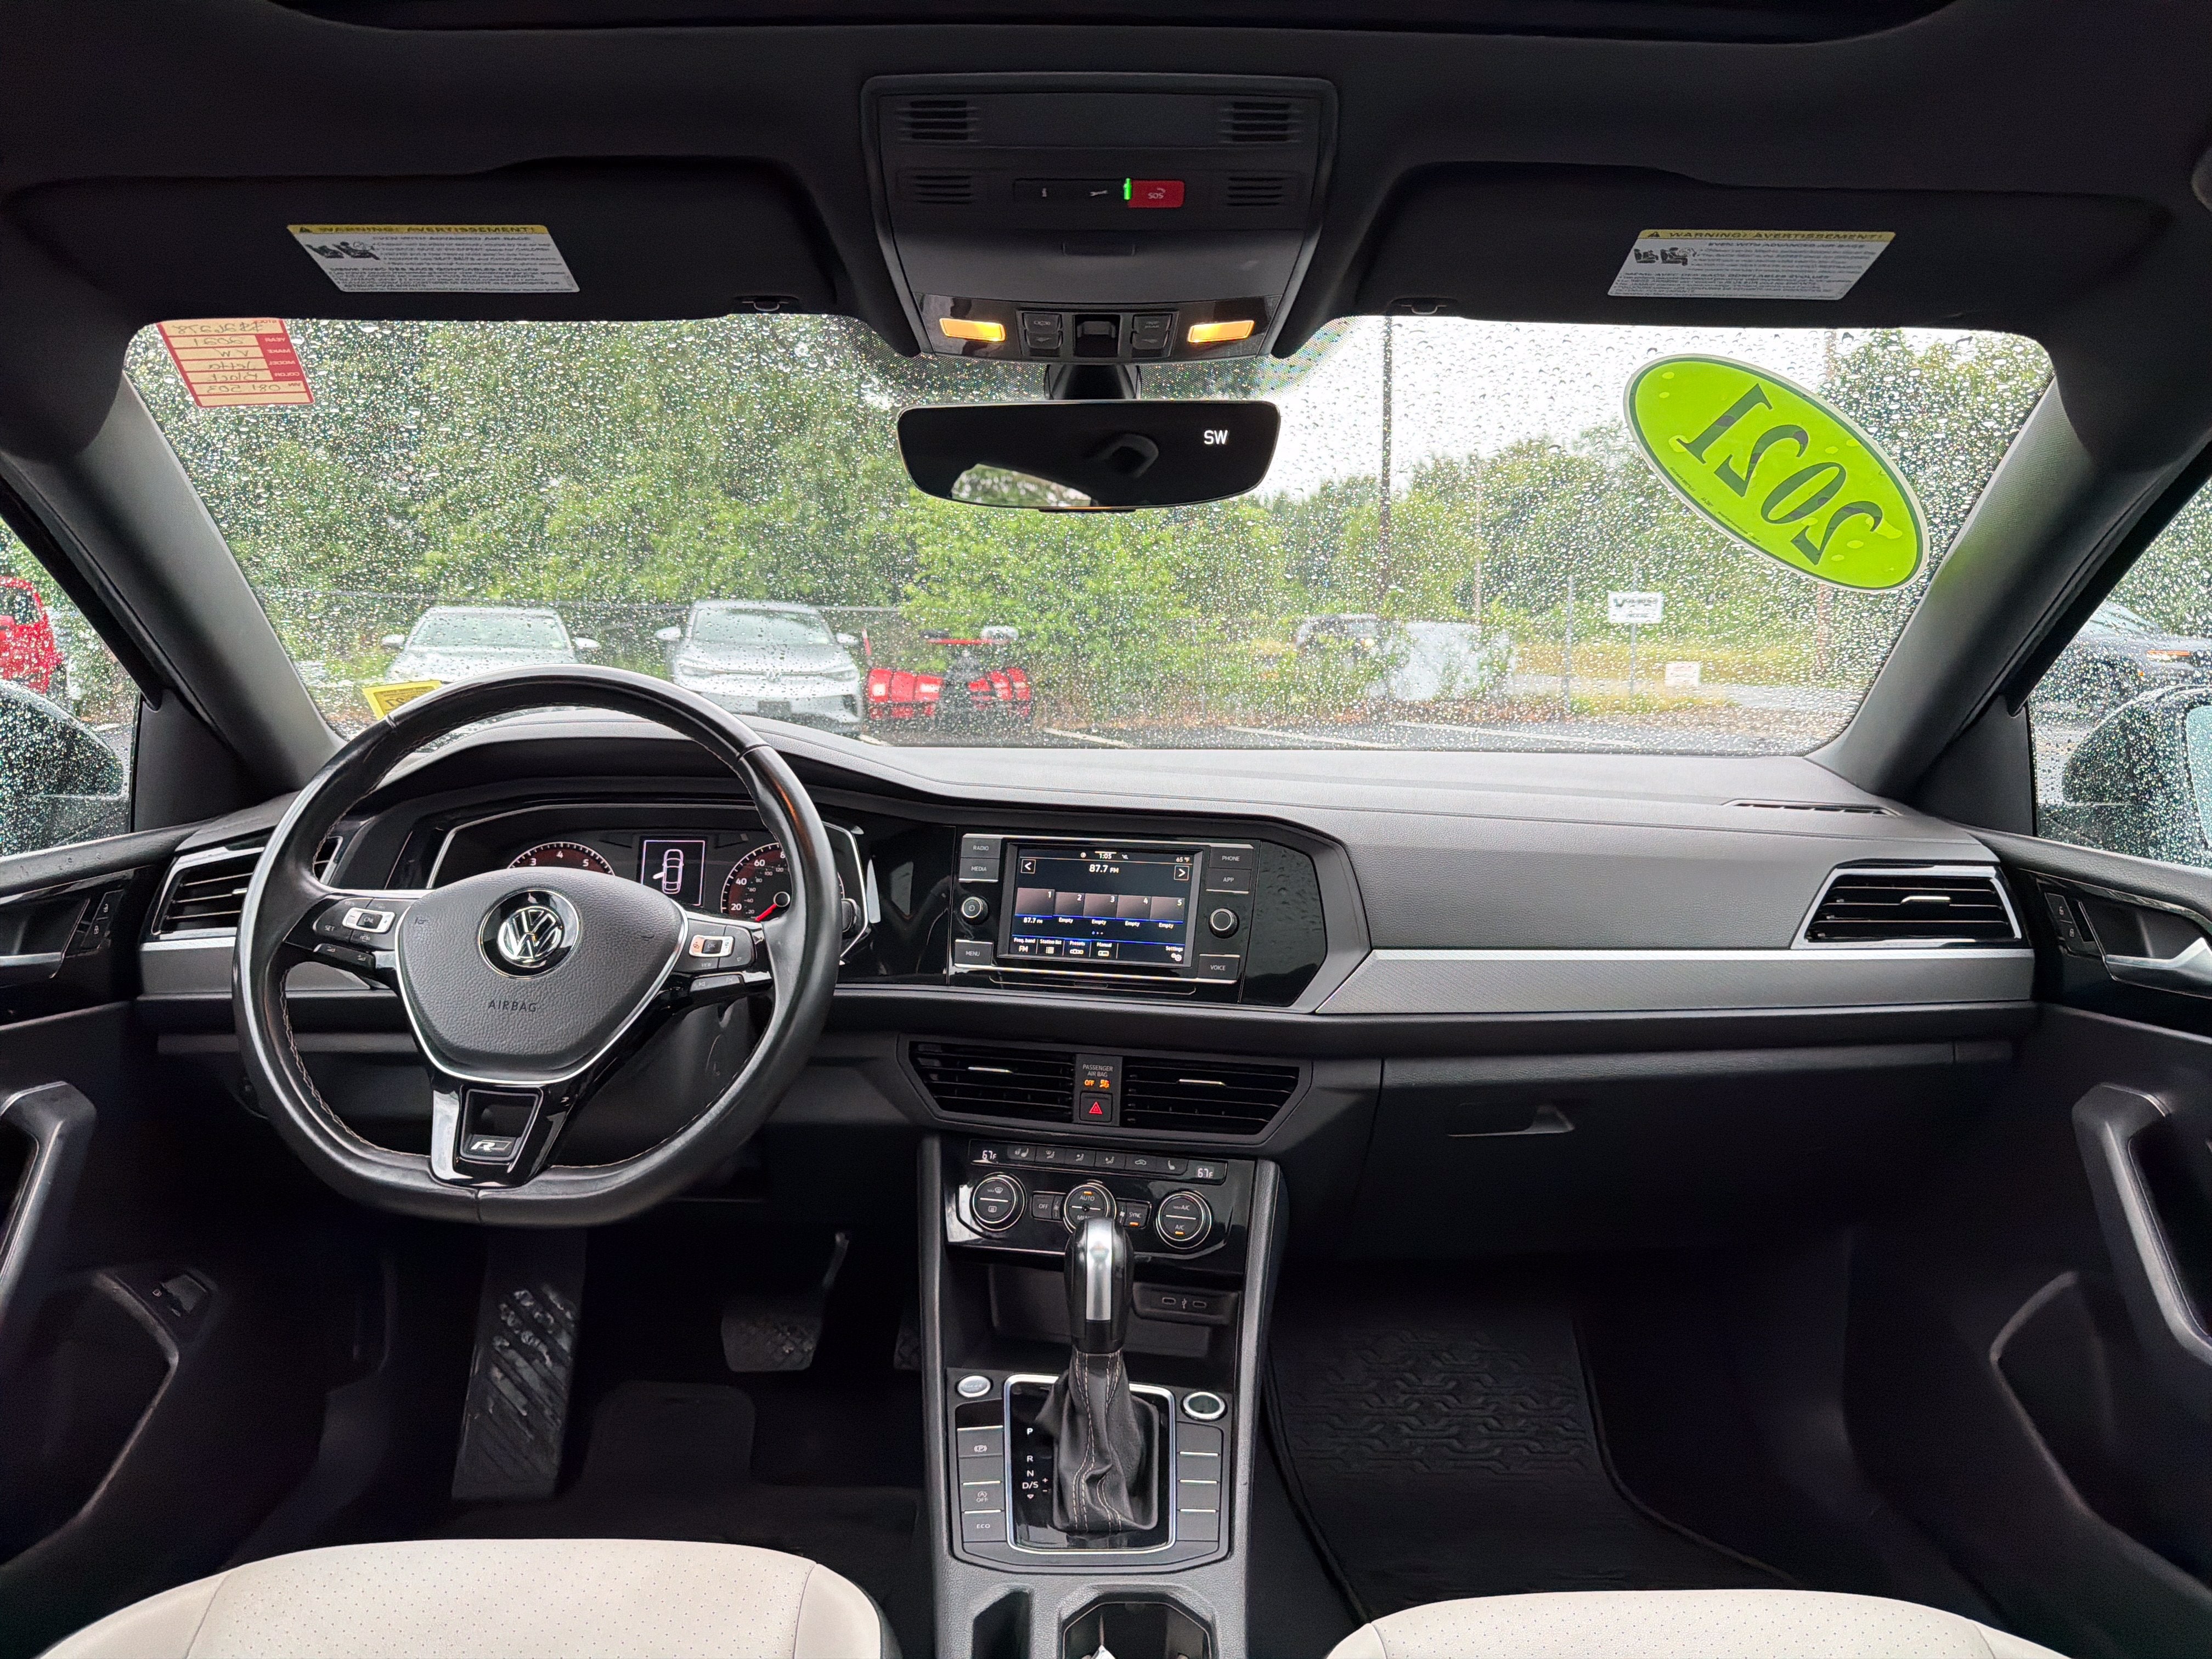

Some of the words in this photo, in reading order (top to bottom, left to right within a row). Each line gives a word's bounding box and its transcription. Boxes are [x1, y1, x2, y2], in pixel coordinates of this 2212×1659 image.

[1204, 430, 1228, 445] SW
[556, 850, 564, 859] 4
[529, 857, 537, 866] 3
[582, 859, 589, 867] 5
[1089, 864, 1109, 873] 87.7
[488, 1000, 537, 1013] AIRBAG
[1022, 1481, 1039, 1489] D/S
